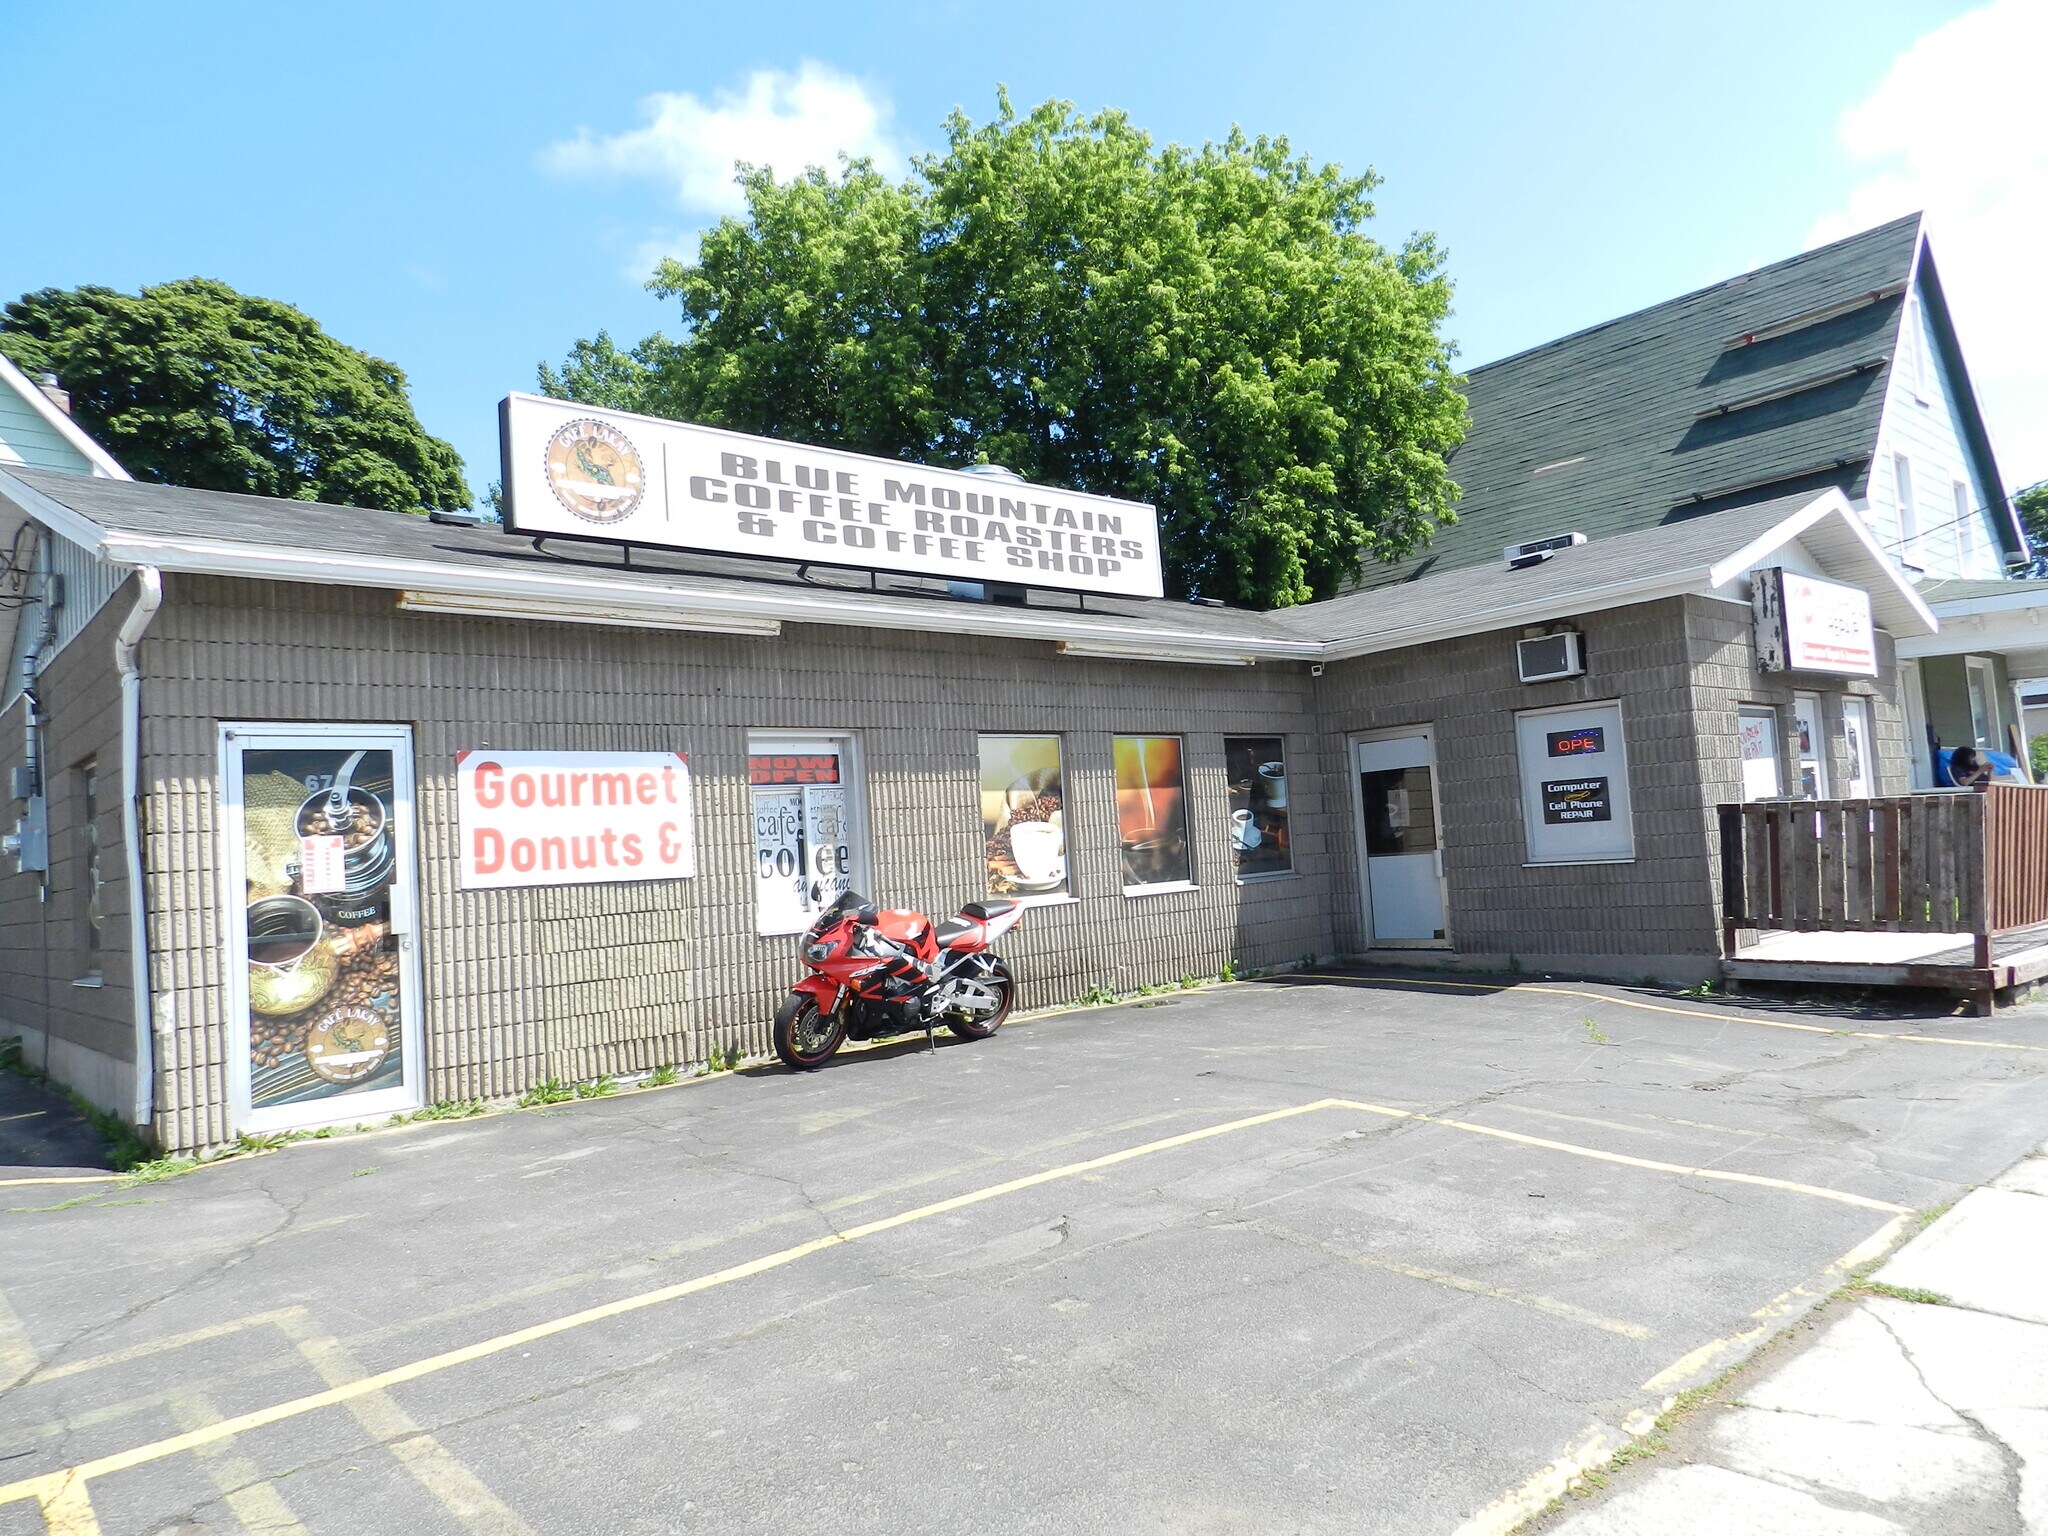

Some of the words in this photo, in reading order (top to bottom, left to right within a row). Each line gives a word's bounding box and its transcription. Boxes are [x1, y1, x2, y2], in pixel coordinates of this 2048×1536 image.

[721, 452, 860, 496] BLUE
[884, 479, 1123, 535] MOUNTAIN
[690, 476, 891, 526] COFFEE
[915, 509, 1144, 560] ROASTERS
[738, 511, 778, 537] &
[803, 519, 986, 563] COFFEE
[1007, 546, 1122, 577] SHOP
[748, 756, 836, 769] NOW
[750, 770, 838, 783] OPEN
[475, 761, 678, 809] Gourmet
[1547, 782, 1602, 793] Computer
[1549, 801, 1567, 811] Cell
[1571, 800, 1604, 809] Phone
[1560, 810, 1594, 819] REPAIR
[474, 827, 644, 874] Donuts
[658, 821, 682, 864] &
[338, 906, 377, 920] COFFEE
[347, 1008, 380, 1026] LAKAY
